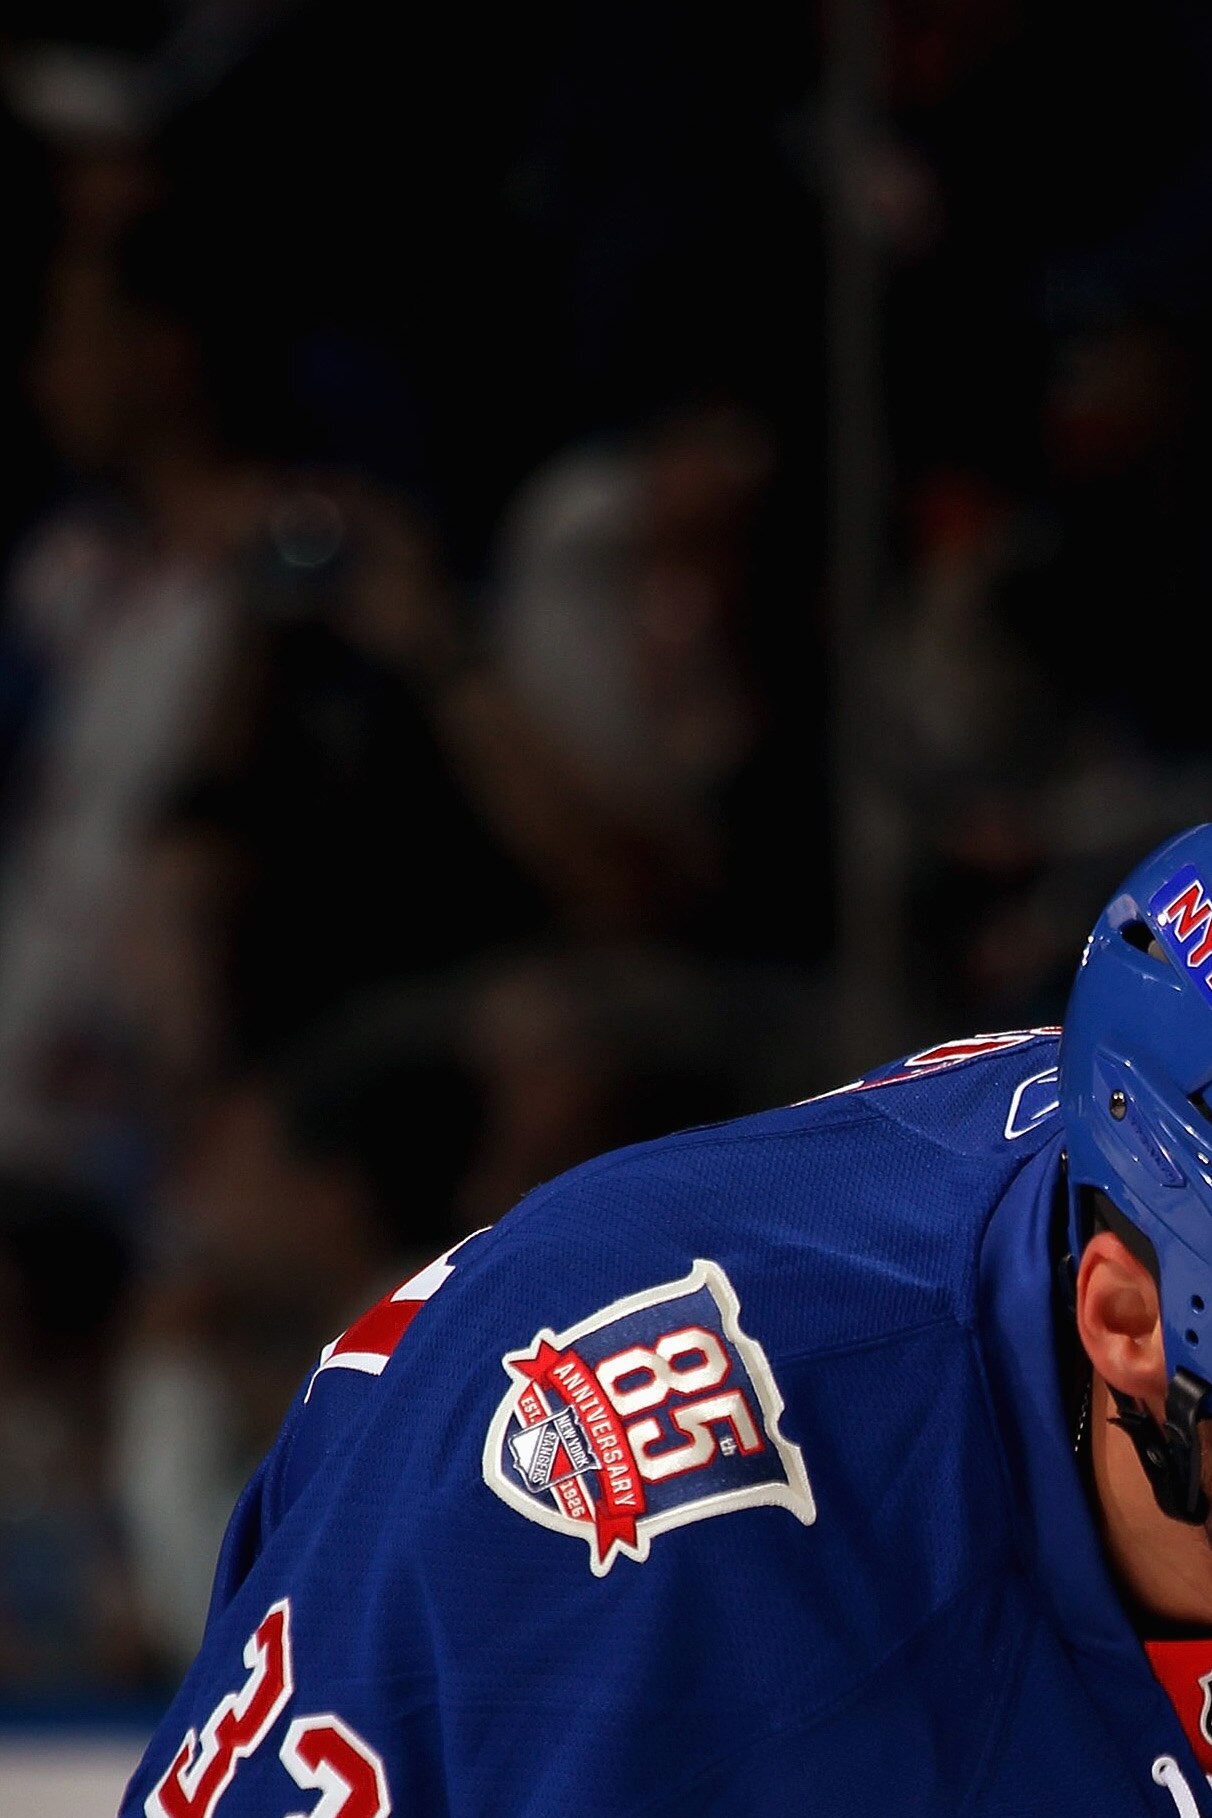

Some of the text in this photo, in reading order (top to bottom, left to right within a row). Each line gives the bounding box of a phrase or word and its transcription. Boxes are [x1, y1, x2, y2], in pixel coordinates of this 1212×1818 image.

[521, 1396, 541, 1423] EST.
[554, 1361, 636, 1507] ANNIVERSARY
[532, 1431, 557, 1486] RANGERS
[558, 1414, 590, 1470] NEW YORK
